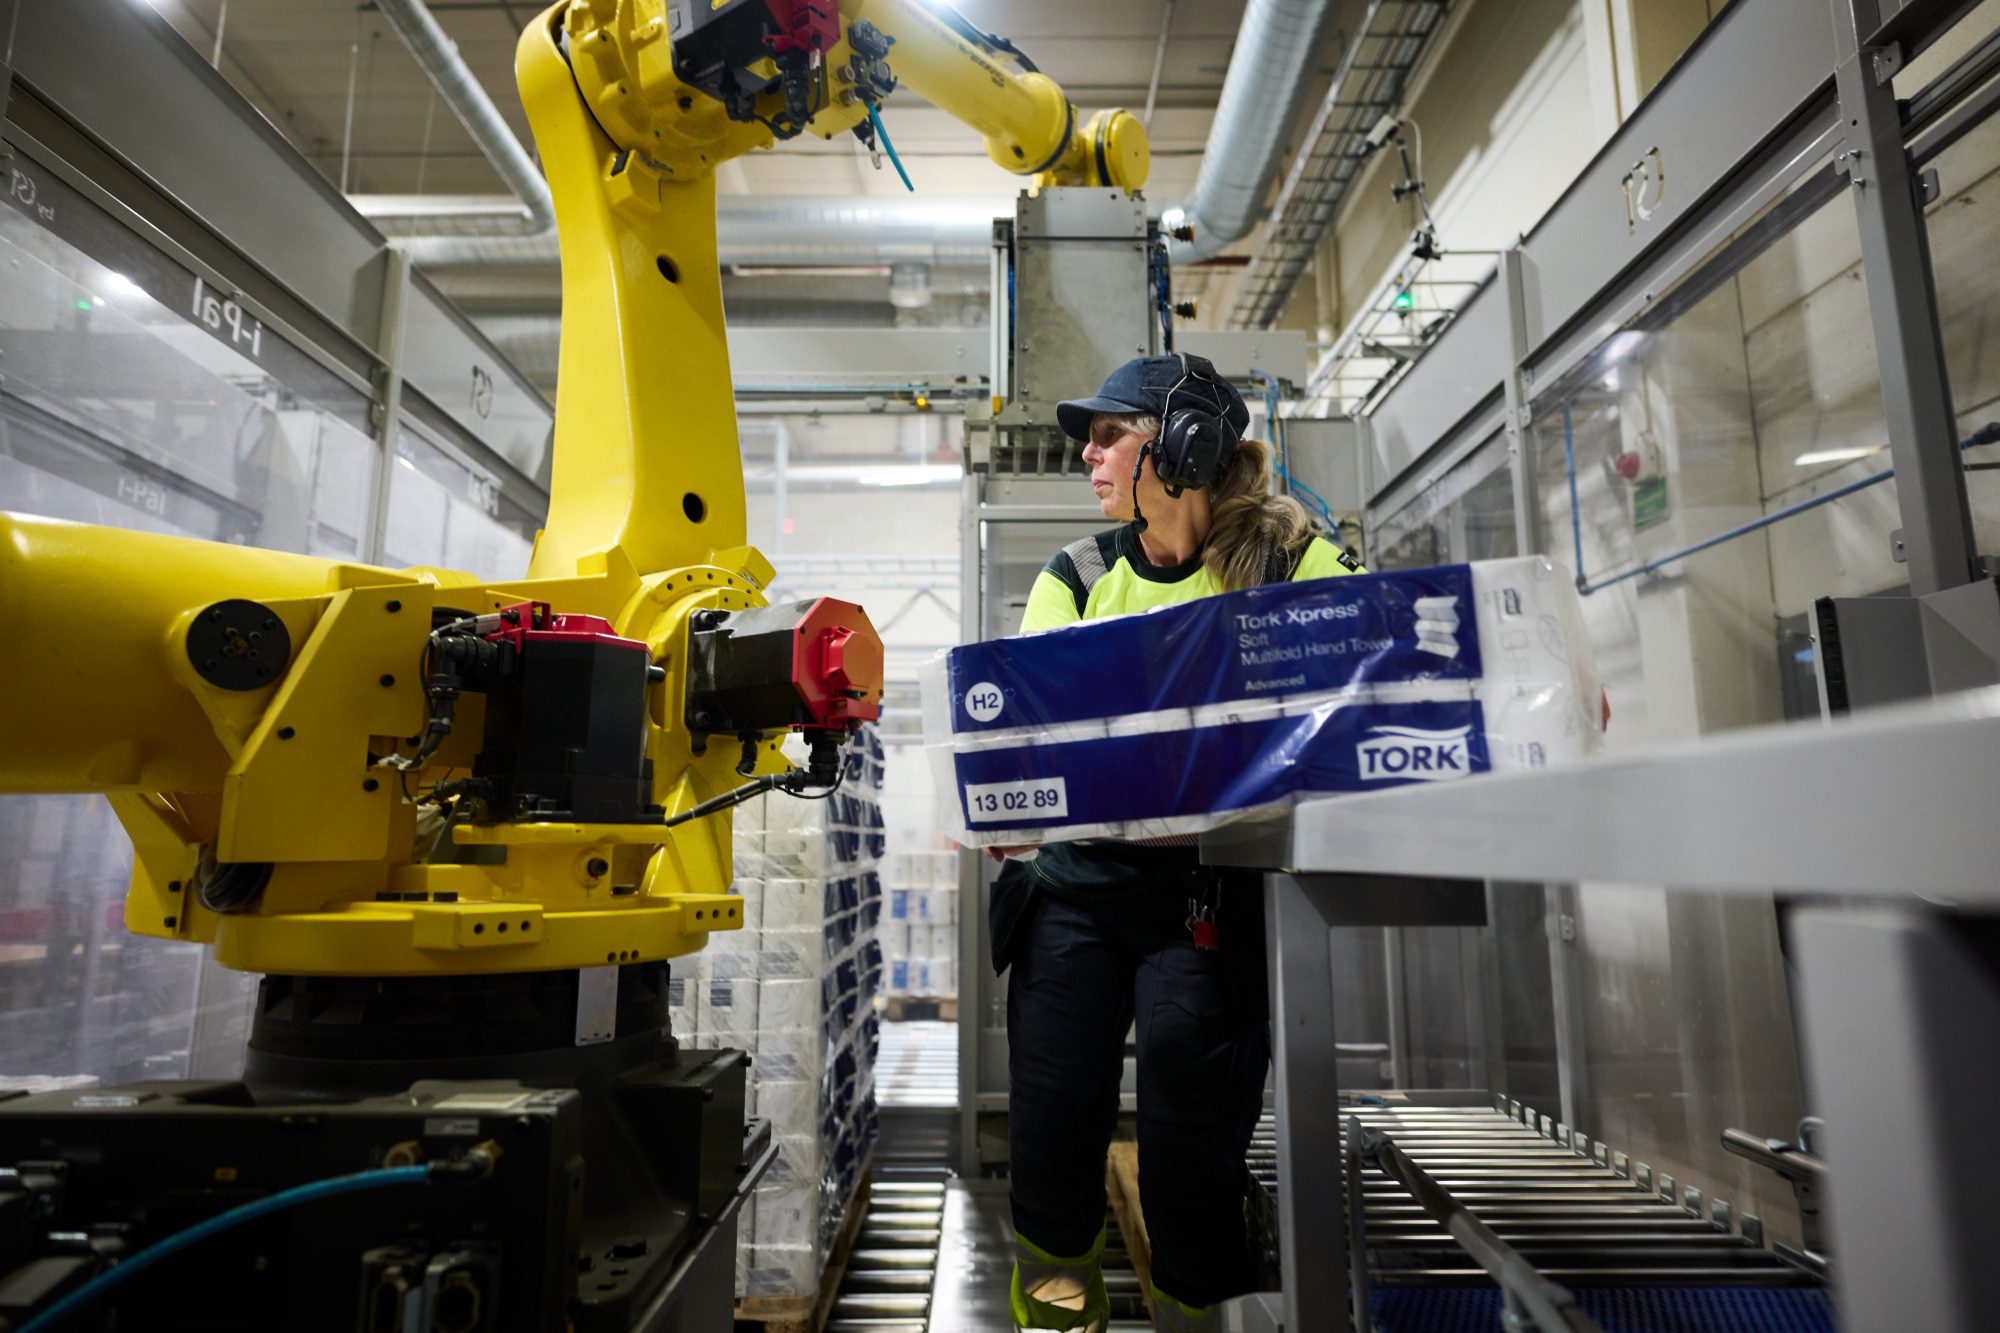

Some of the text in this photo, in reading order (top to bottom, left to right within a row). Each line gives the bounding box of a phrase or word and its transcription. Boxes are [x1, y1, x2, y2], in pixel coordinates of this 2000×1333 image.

[1236, 604, 1360, 630] Tork Xpress
[1239, 633, 1269, 649] Soft
[1241, 647, 1302, 667] Multifold
[1305, 640, 1347, 657] Hand
[1245, 674, 1306, 692] Advanced
[972, 692, 999, 711] H2
[1363, 745, 1462, 773] TORK
[975, 788, 1059, 812] 13 02 89
